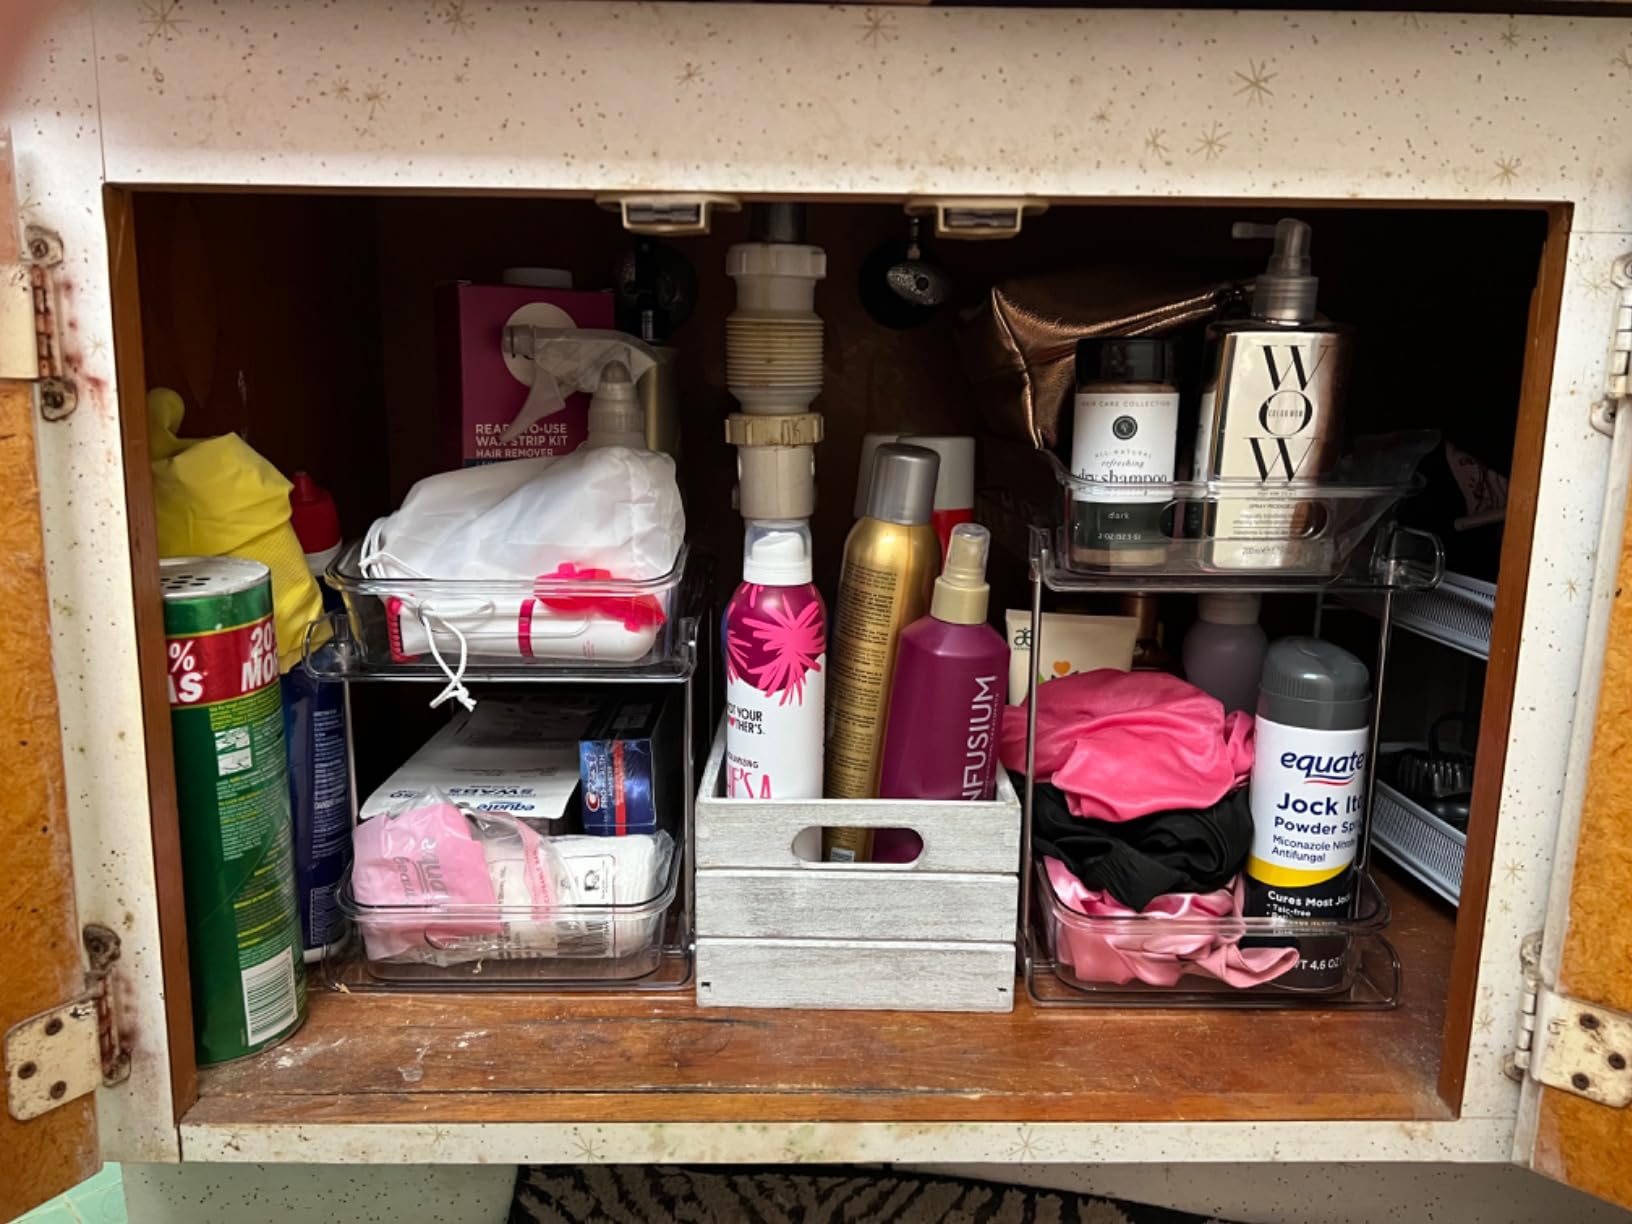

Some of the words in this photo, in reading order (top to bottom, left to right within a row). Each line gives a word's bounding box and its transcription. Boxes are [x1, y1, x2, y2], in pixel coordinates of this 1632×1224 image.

[549, 436, 568, 447] KIT
[476, 449, 502, 458] HAIR
[505, 448, 553, 457] REMOVER
[736, 707, 763, 722] YOUR
[1281, 750, 1365, 779] equate
[476, 801, 536, 812] equate
[1277, 792, 1339, 816] Jock
[1274, 815, 1338, 835] Powder
[1272, 834, 1332, 852] Miconazole
[1271, 846, 1327, 864] Antifungal
[1267, 890, 1302, 907] Cures
[1305, 897, 1333, 908] Most
